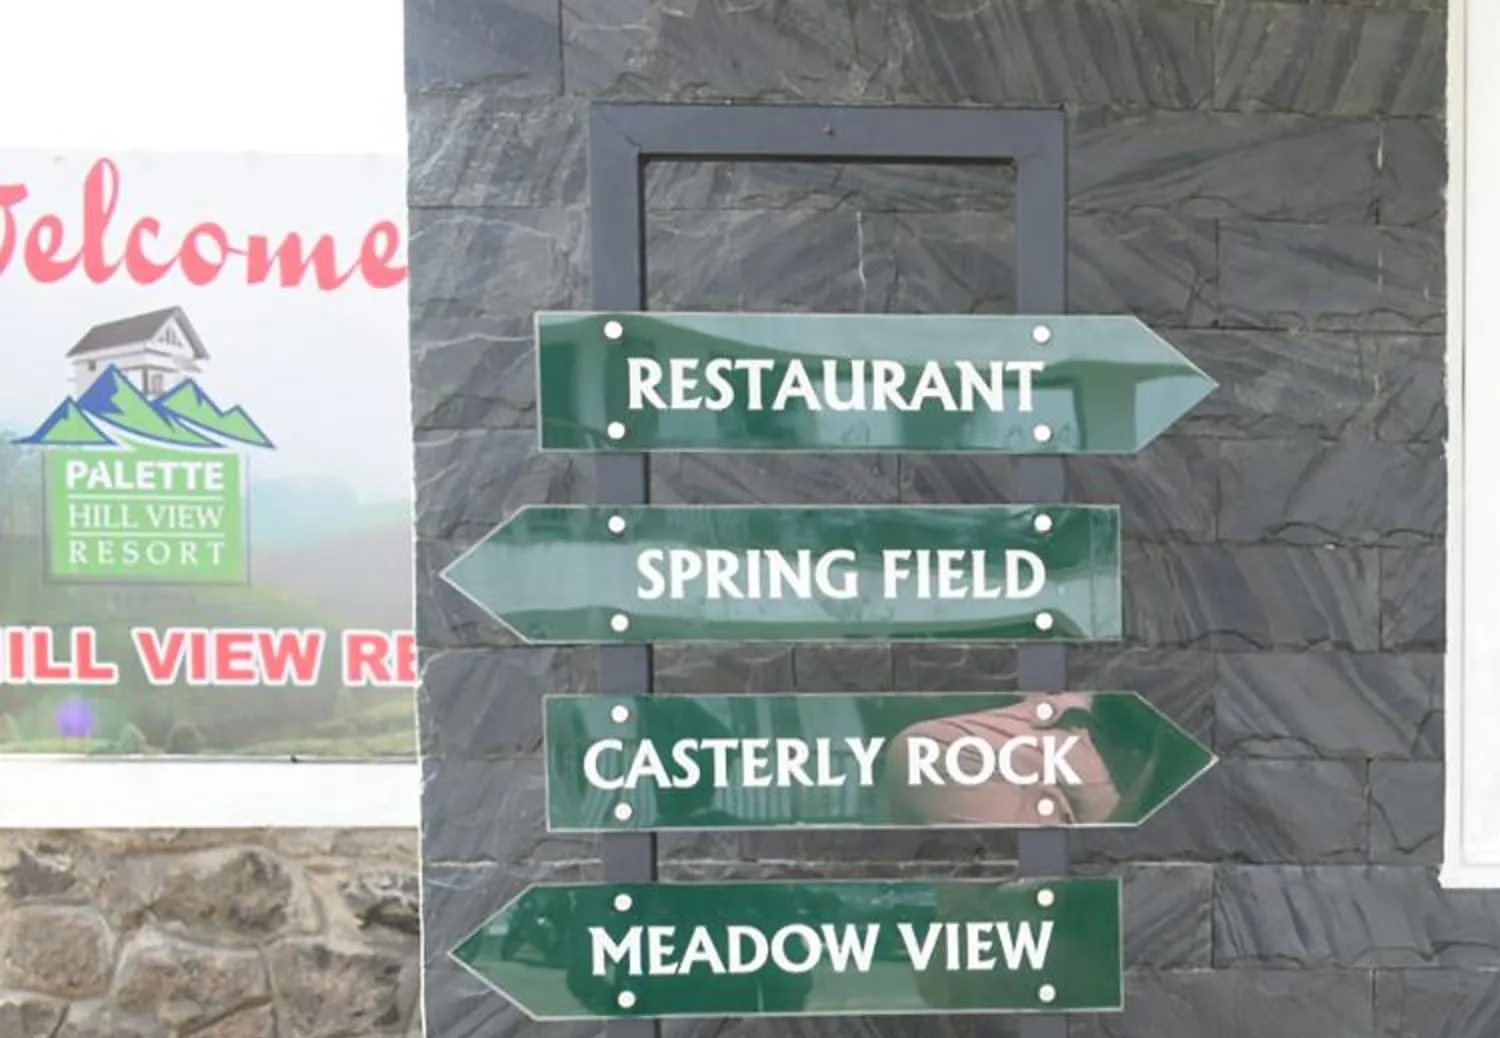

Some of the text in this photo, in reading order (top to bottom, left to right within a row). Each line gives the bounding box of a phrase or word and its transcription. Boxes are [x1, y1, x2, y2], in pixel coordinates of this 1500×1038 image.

[627, 357, 1046, 413] RESTAURANT
[66, 460, 225, 490] PALETTE
[69, 503, 224, 530] HILL VIEW
[69, 540, 225, 566] RESORT
[636, 548, 1046, 601] SPRING FIELD
[0, 627, 118, 684] ILL
[132, 628, 326, 685] VIEW
[583, 734, 1083, 791] CASTERLY ROCK
[588, 920, 1054, 976] MEADOW VIEW
